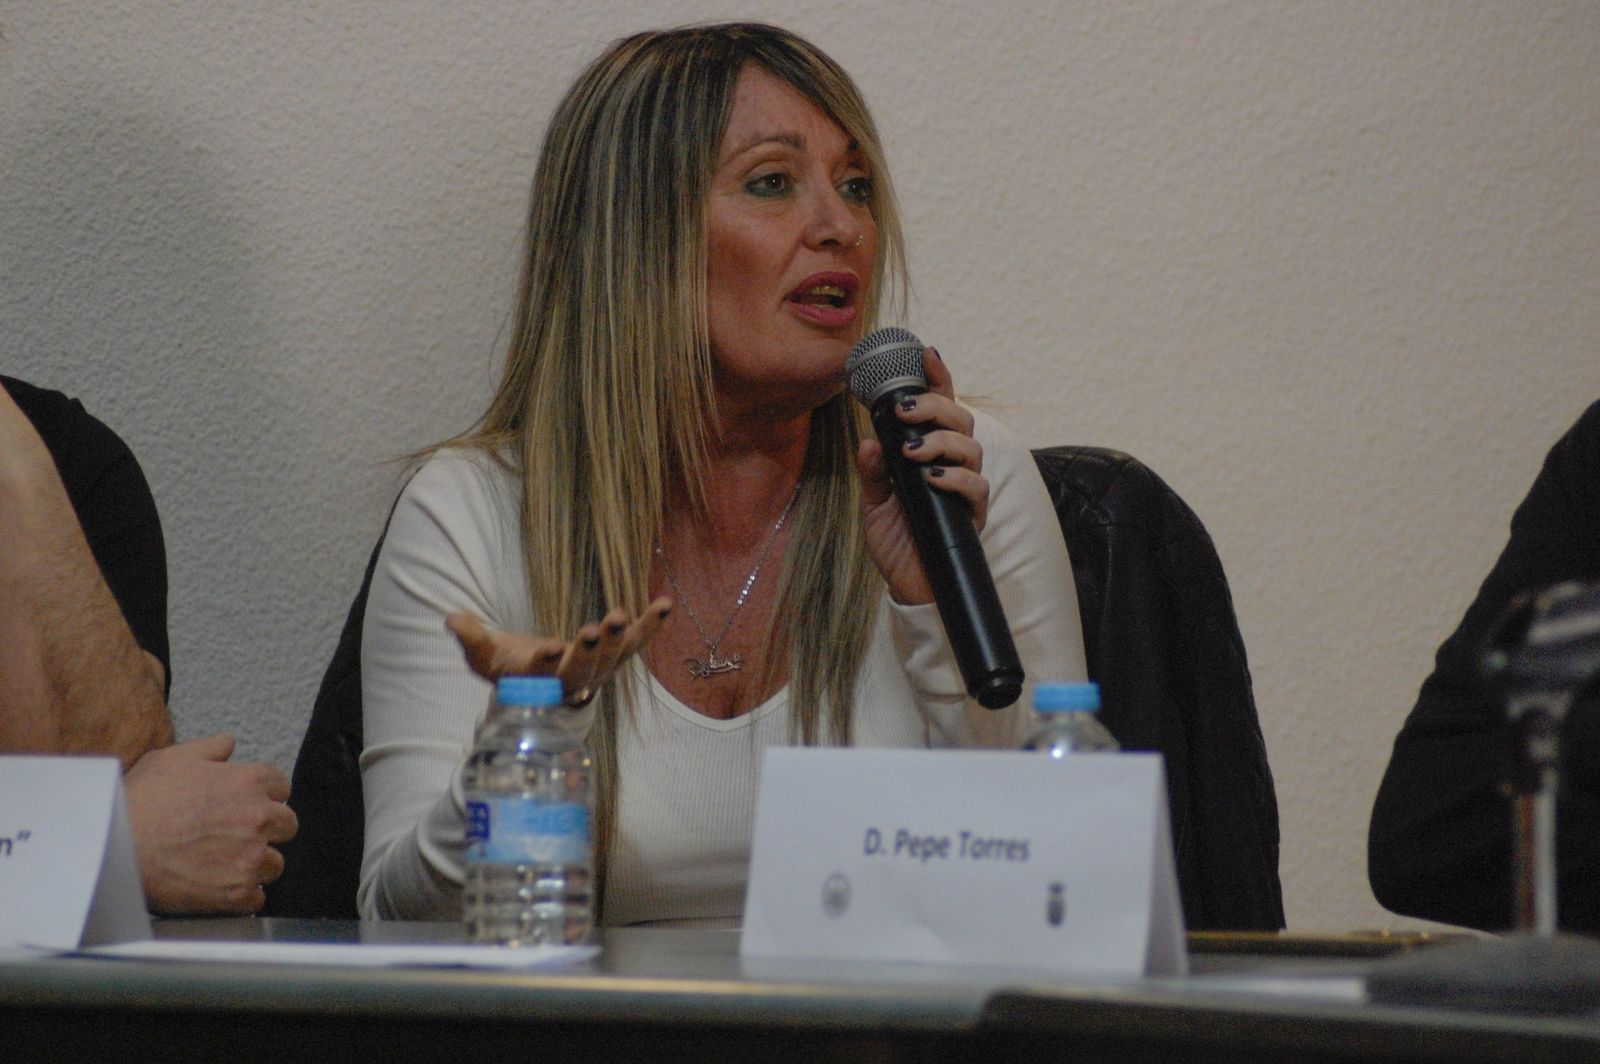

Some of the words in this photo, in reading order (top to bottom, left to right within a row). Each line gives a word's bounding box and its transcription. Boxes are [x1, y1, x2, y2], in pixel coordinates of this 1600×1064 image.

[864, 827, 887, 856] D.
[895, 828, 949, 863] Pepe
[959, 831, 1030, 861] Torres
